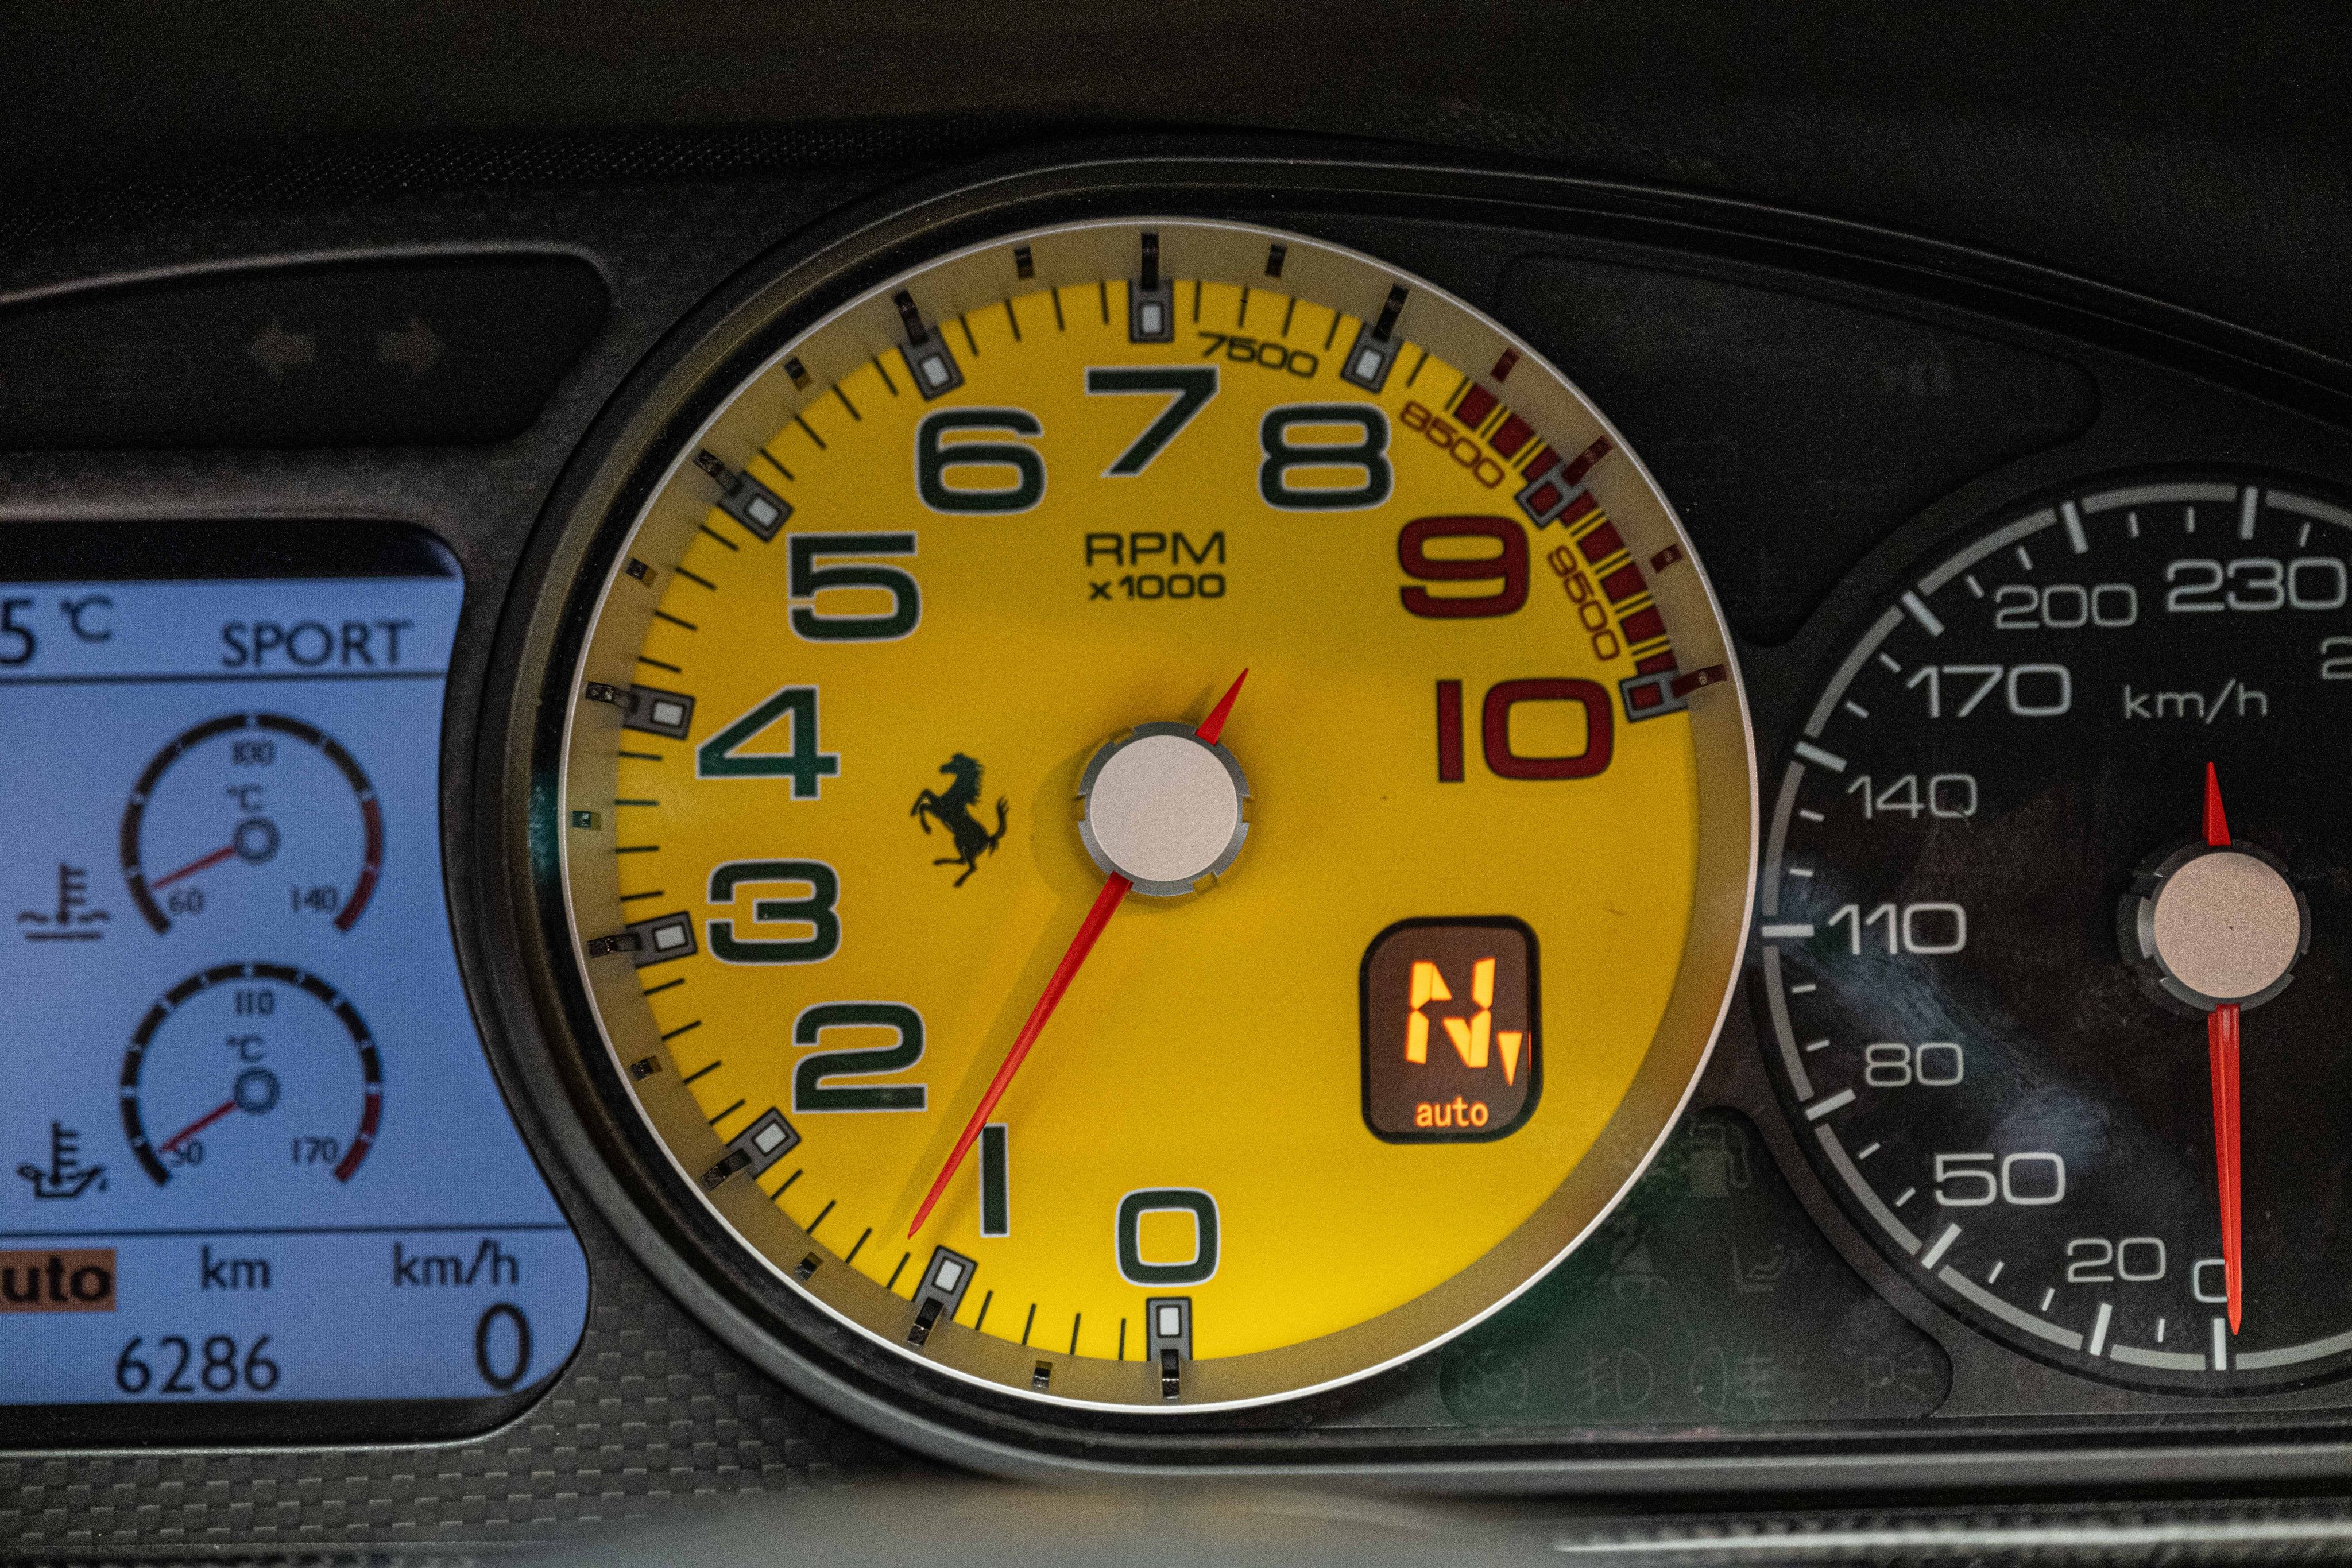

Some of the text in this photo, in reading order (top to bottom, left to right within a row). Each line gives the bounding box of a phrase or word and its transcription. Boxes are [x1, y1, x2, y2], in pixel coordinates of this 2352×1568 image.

[1198, 332, 1320, 379] 7500
[1084, 365, 1220, 477] 7
[1399, 401, 1506, 490] 8500
[914, 406, 1047, 516] 6
[1258, 402, 1394, 512] 8
[1085, 531, 1226, 566] RPM
[1397, 514, 1530, 620] 9
[787, 531, 922, 643] 5
[1547, 544, 1620, 661] 9500
[1995, 583, 2138, 629] 200
[2166, 557, 2347, 612] 230
[0, 597, 36, 666] 5
[220, 620, 413, 668] SPORT
[1906, 664, 2072, 718] 170
[2123, 678, 2268, 725] km/h
[695, 685, 840, 800] 4
[1436, 677, 1615, 783] 10
[1847, 773, 1978, 819] 140
[168, 887, 204, 915] 60
[290, 886, 338, 913] 140
[707, 858, 841, 966] 3
[1828, 903, 1967, 955] 110
[235, 989, 274, 1016] 110
[1405, 957, 1496, 1068] N
[792, 1000, 928, 1114] 2
[1864, 1042, 1964, 1087] 80
[1415, 1095, 1490, 1128] auto
[291, 1137, 339, 1165] 170
[978, 1122, 1009, 1238] 1
[1934, 1152, 2065, 1207] 50
[393, 1238, 520, 1287] km/h
[1115, 1186, 1220, 1287] 0
[2068, 1237, 2167, 1283] 20
[200, 1244, 272, 1289] km
[116, 1335, 281, 1394] 6286
[474, 1302, 532, 1391] 0
